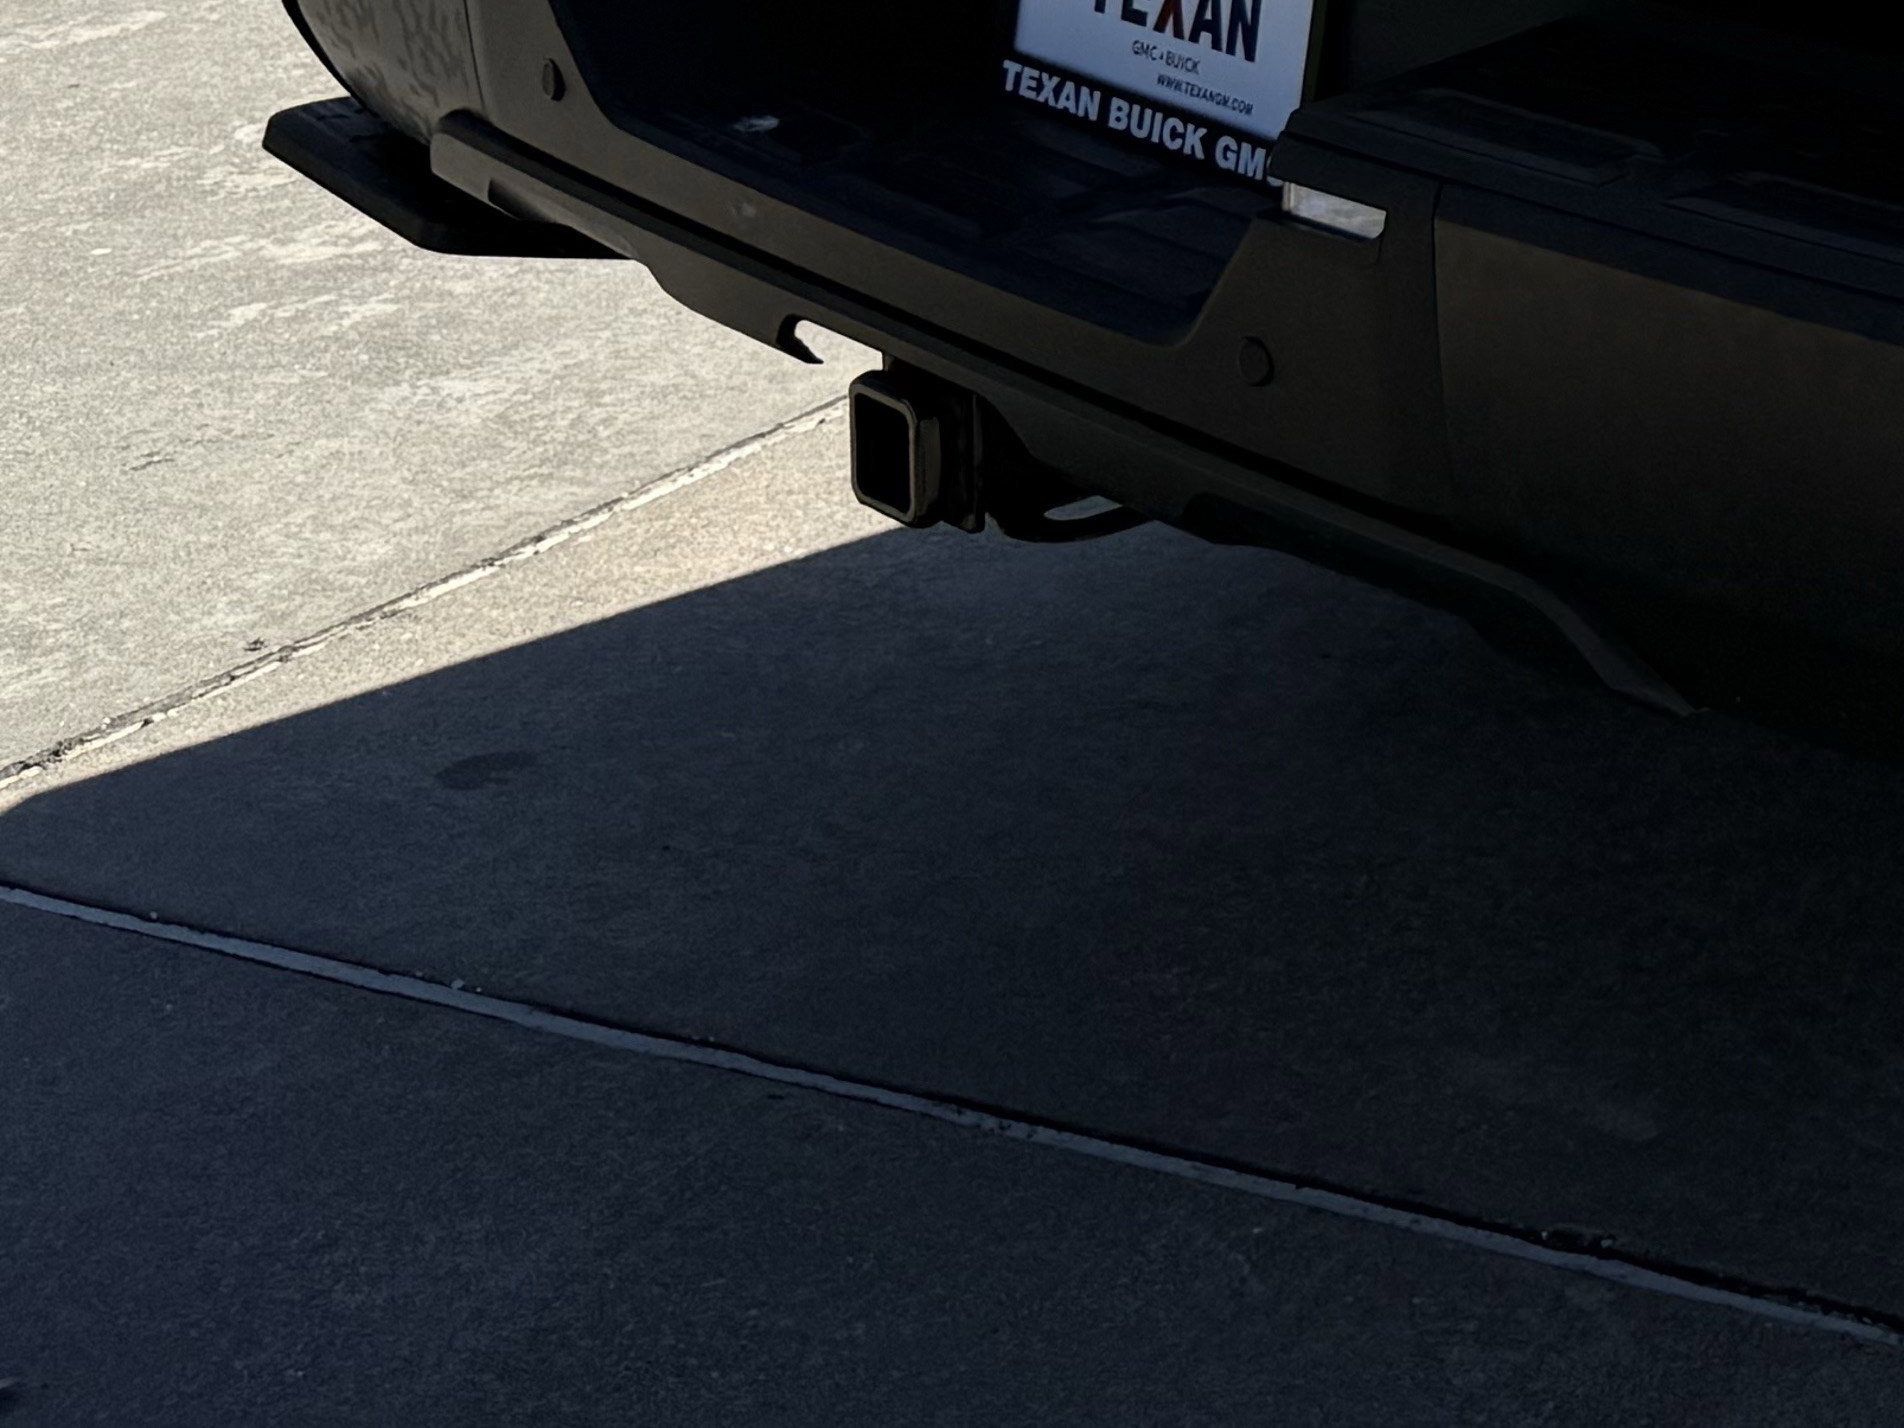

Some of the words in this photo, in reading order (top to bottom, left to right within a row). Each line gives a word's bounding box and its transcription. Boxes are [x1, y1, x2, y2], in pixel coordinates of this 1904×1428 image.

[1002, 59, 1101, 122] TEXAN
[1107, 96, 1208, 160] BUICK
[1214, 134, 1285, 188] GM
